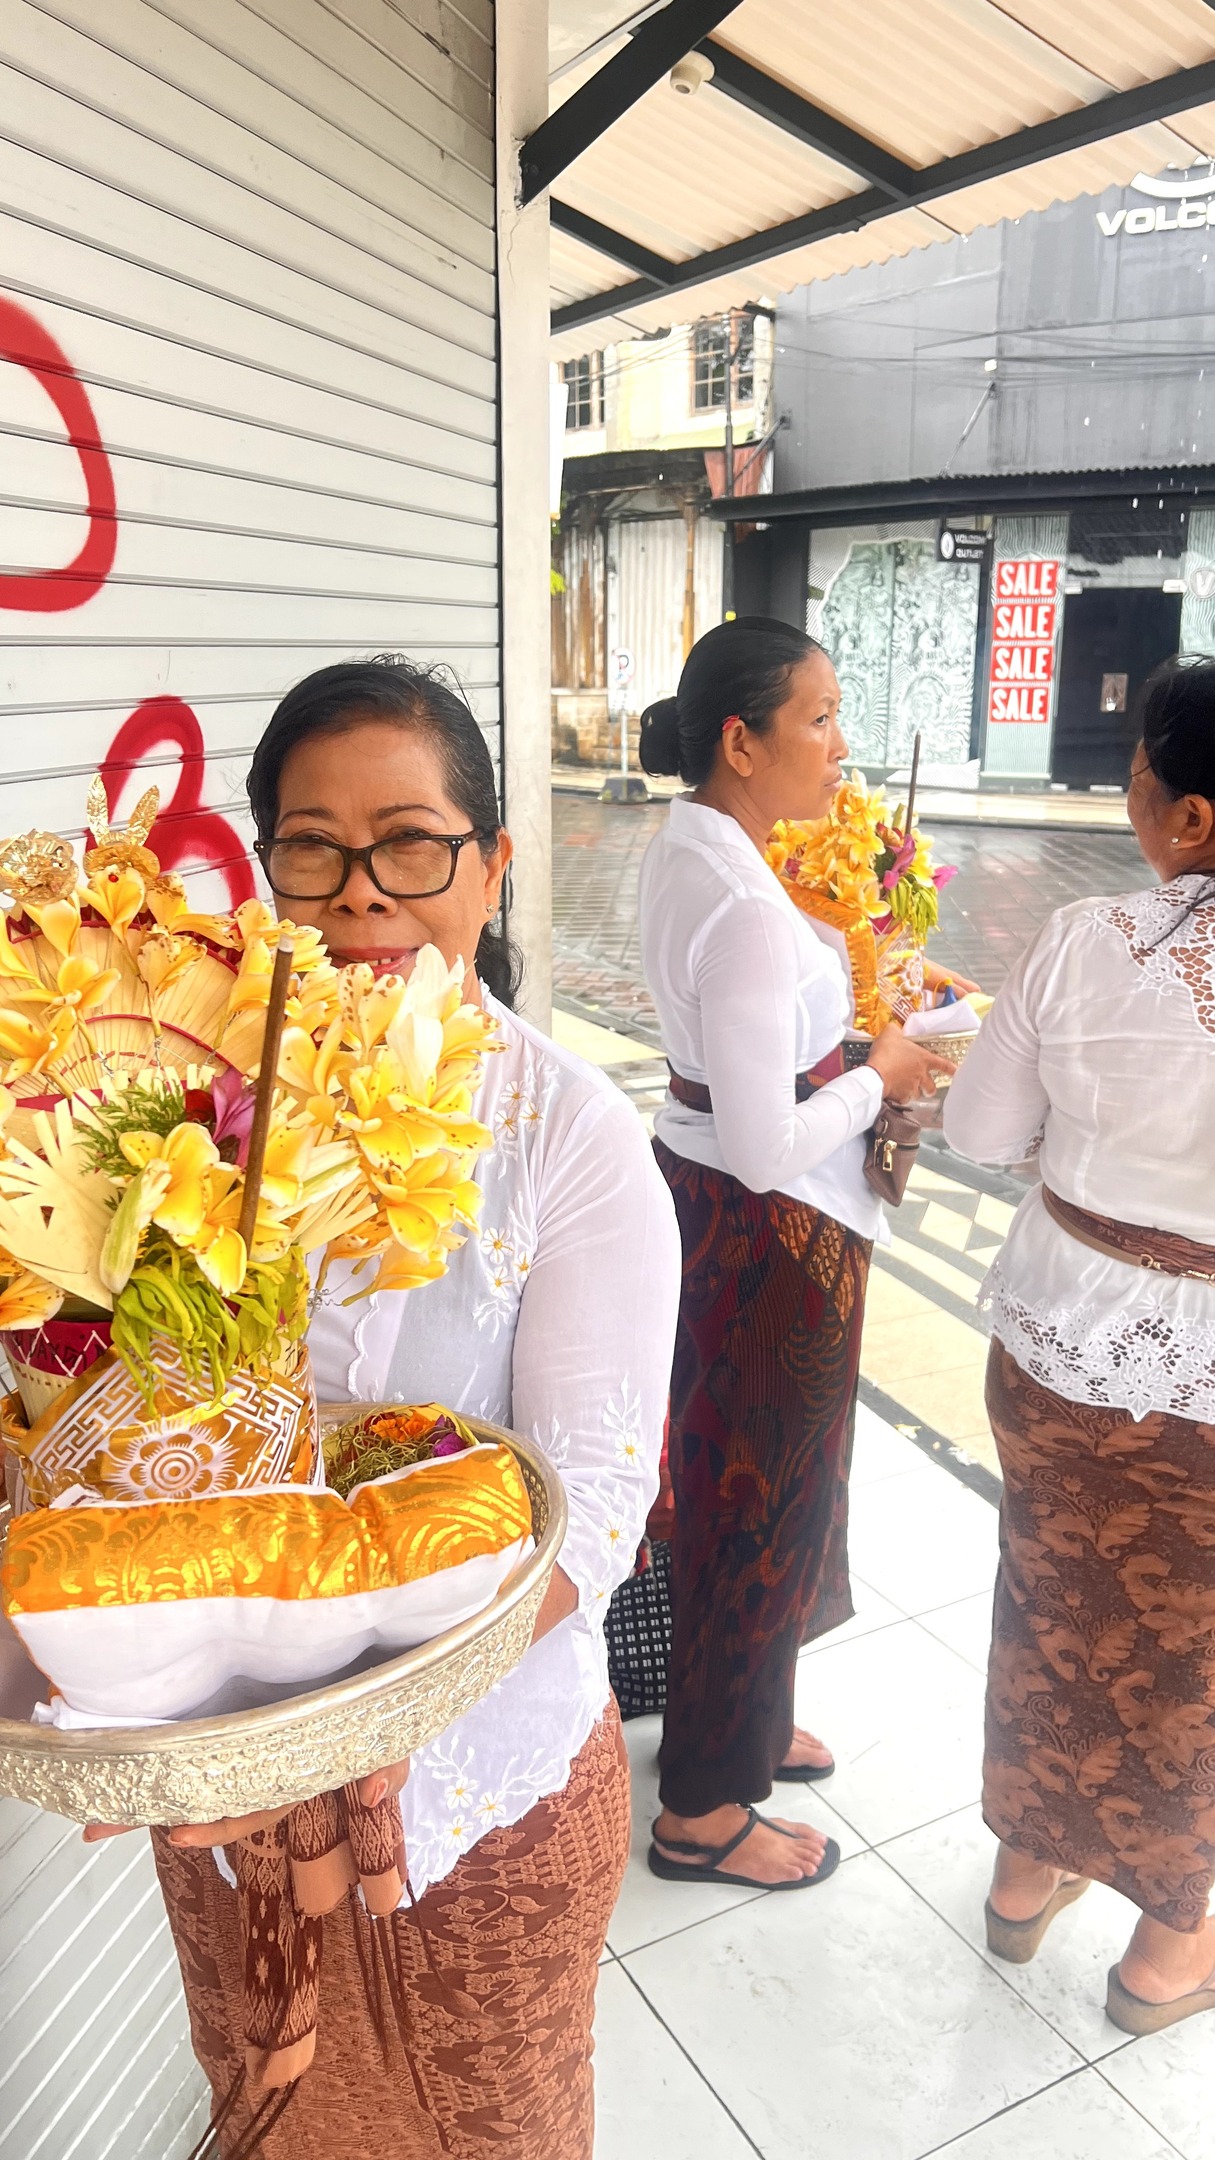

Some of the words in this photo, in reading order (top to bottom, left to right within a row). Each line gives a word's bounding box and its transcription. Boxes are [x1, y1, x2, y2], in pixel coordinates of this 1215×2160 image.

[999, 563, 1055, 596] SALE
[996, 605, 1051, 638] SALE
[994, 647, 1050, 680] SALE
[991, 688, 1046, 721] SALE
